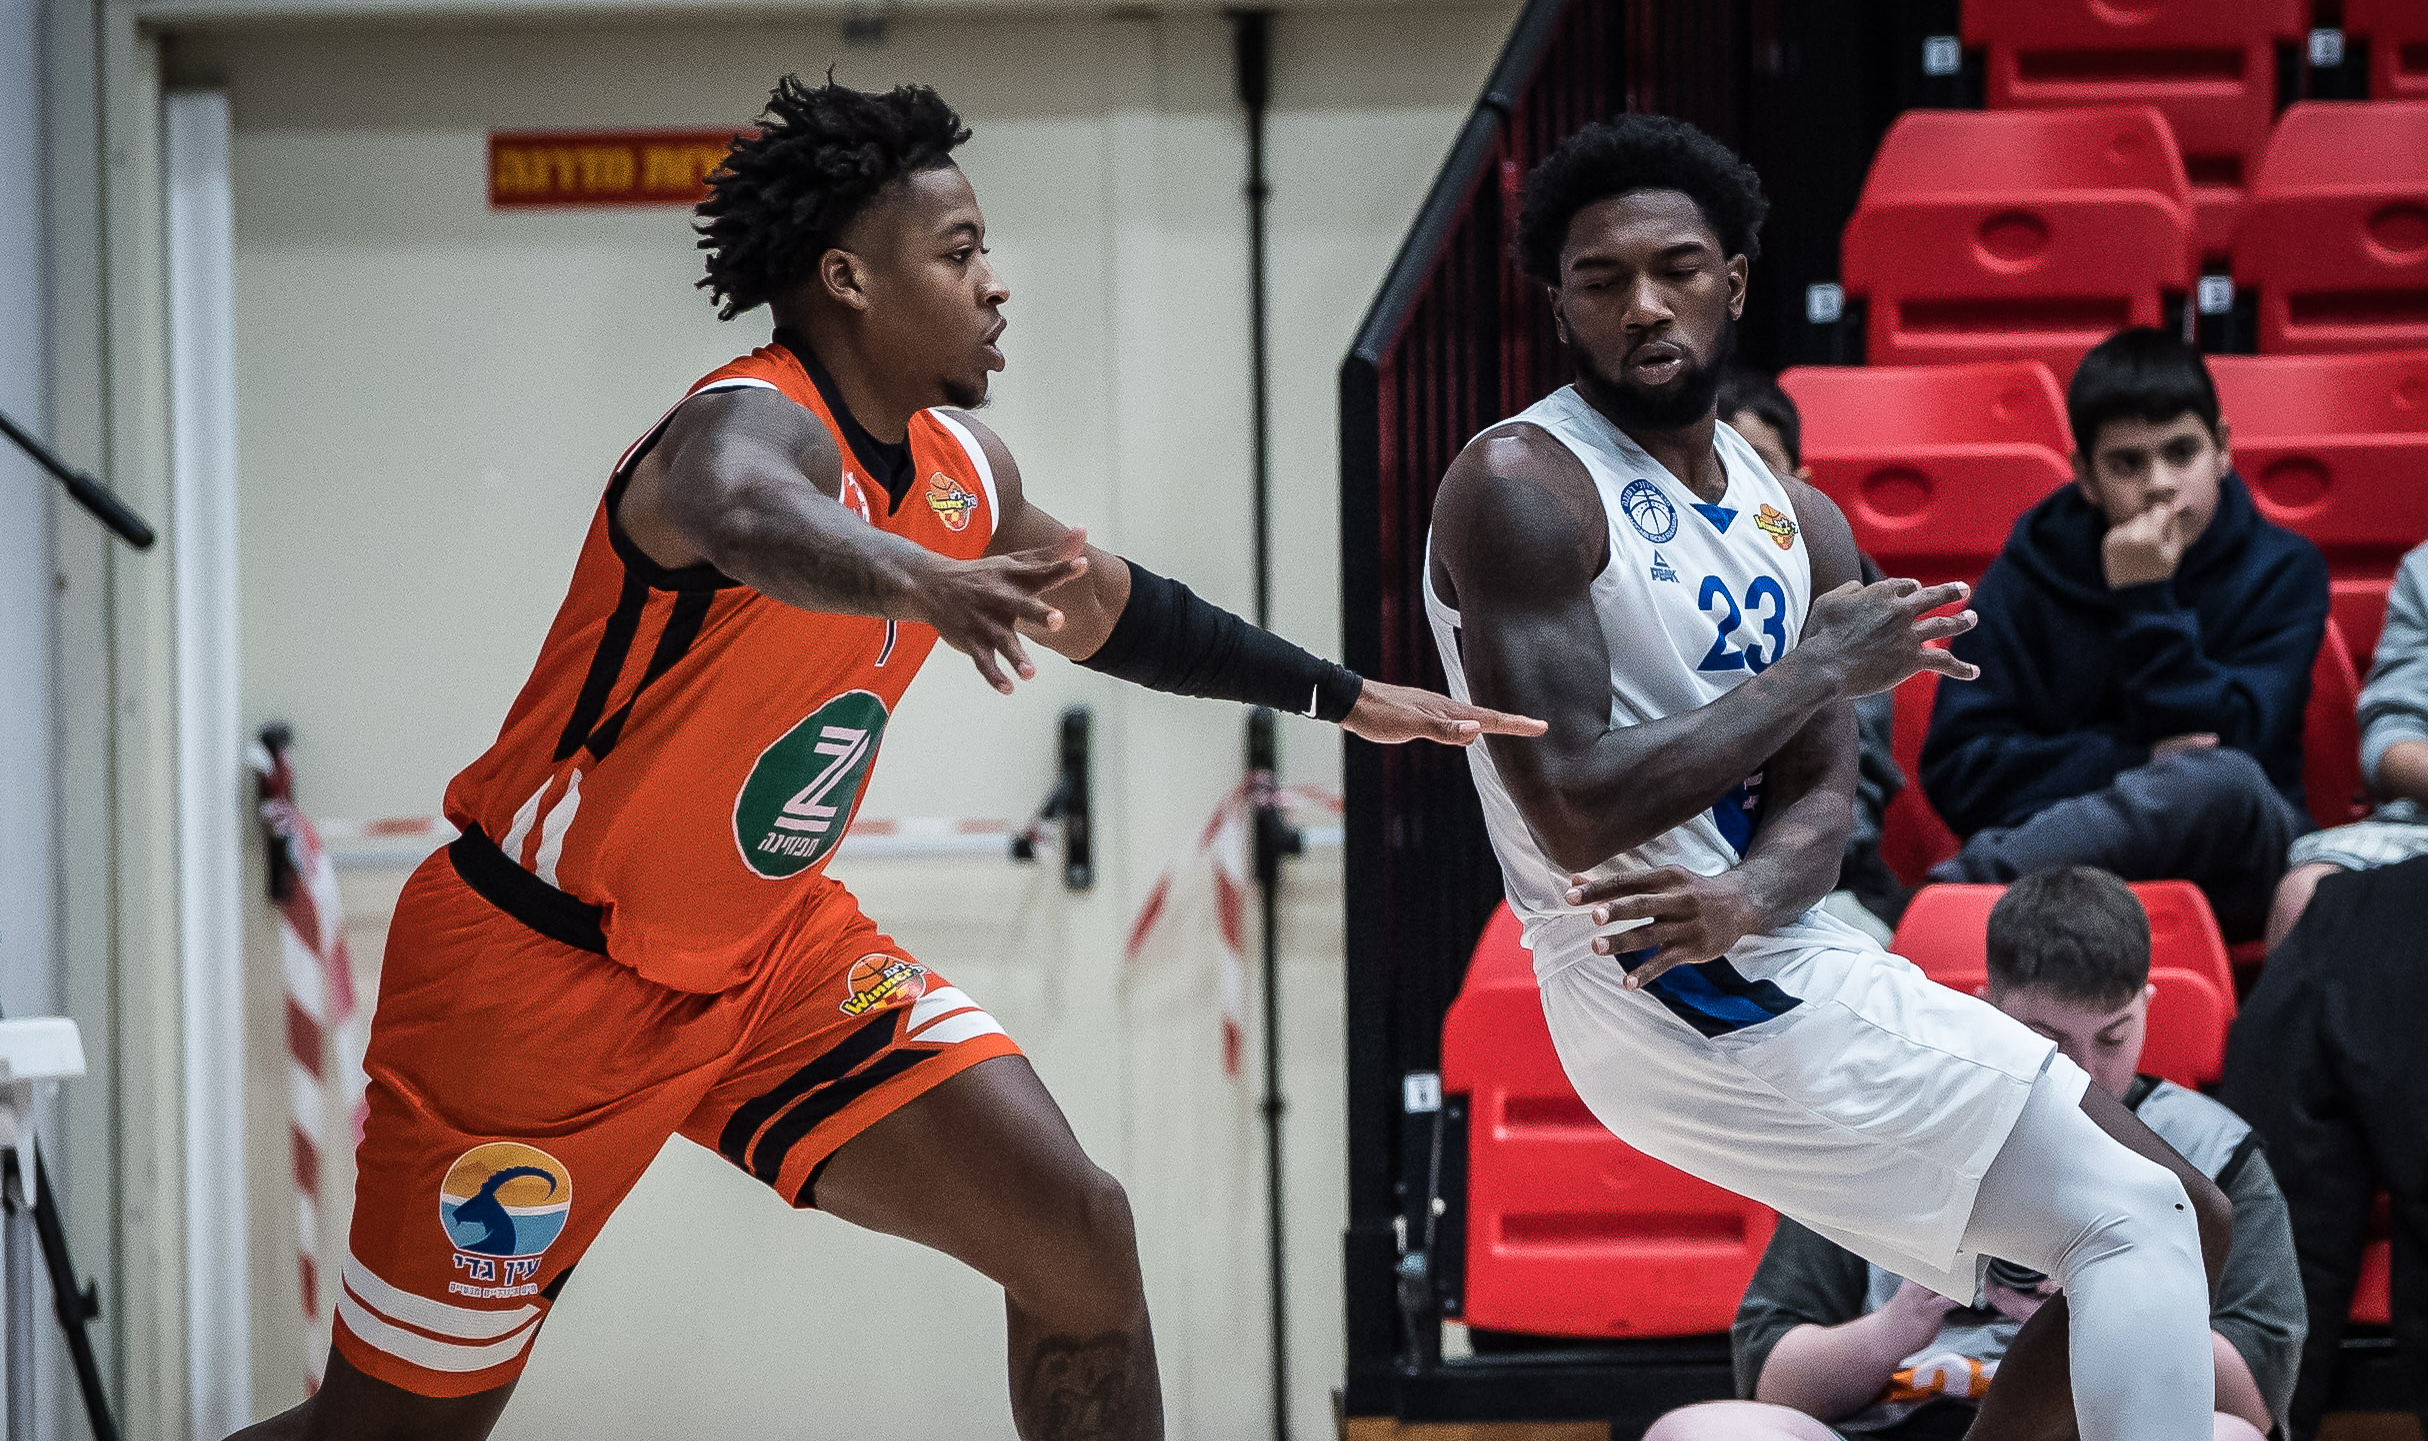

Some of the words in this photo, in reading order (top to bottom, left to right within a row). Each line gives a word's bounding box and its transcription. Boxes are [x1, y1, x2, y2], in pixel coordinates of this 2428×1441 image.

[1650, 566, 1680, 584] PEAK
[1696, 574, 1786, 677] 23
[842, 966, 913, 1015] Winner
[453, 1253, 495, 1281] גדי
[504, 1257, 542, 1286] עין
